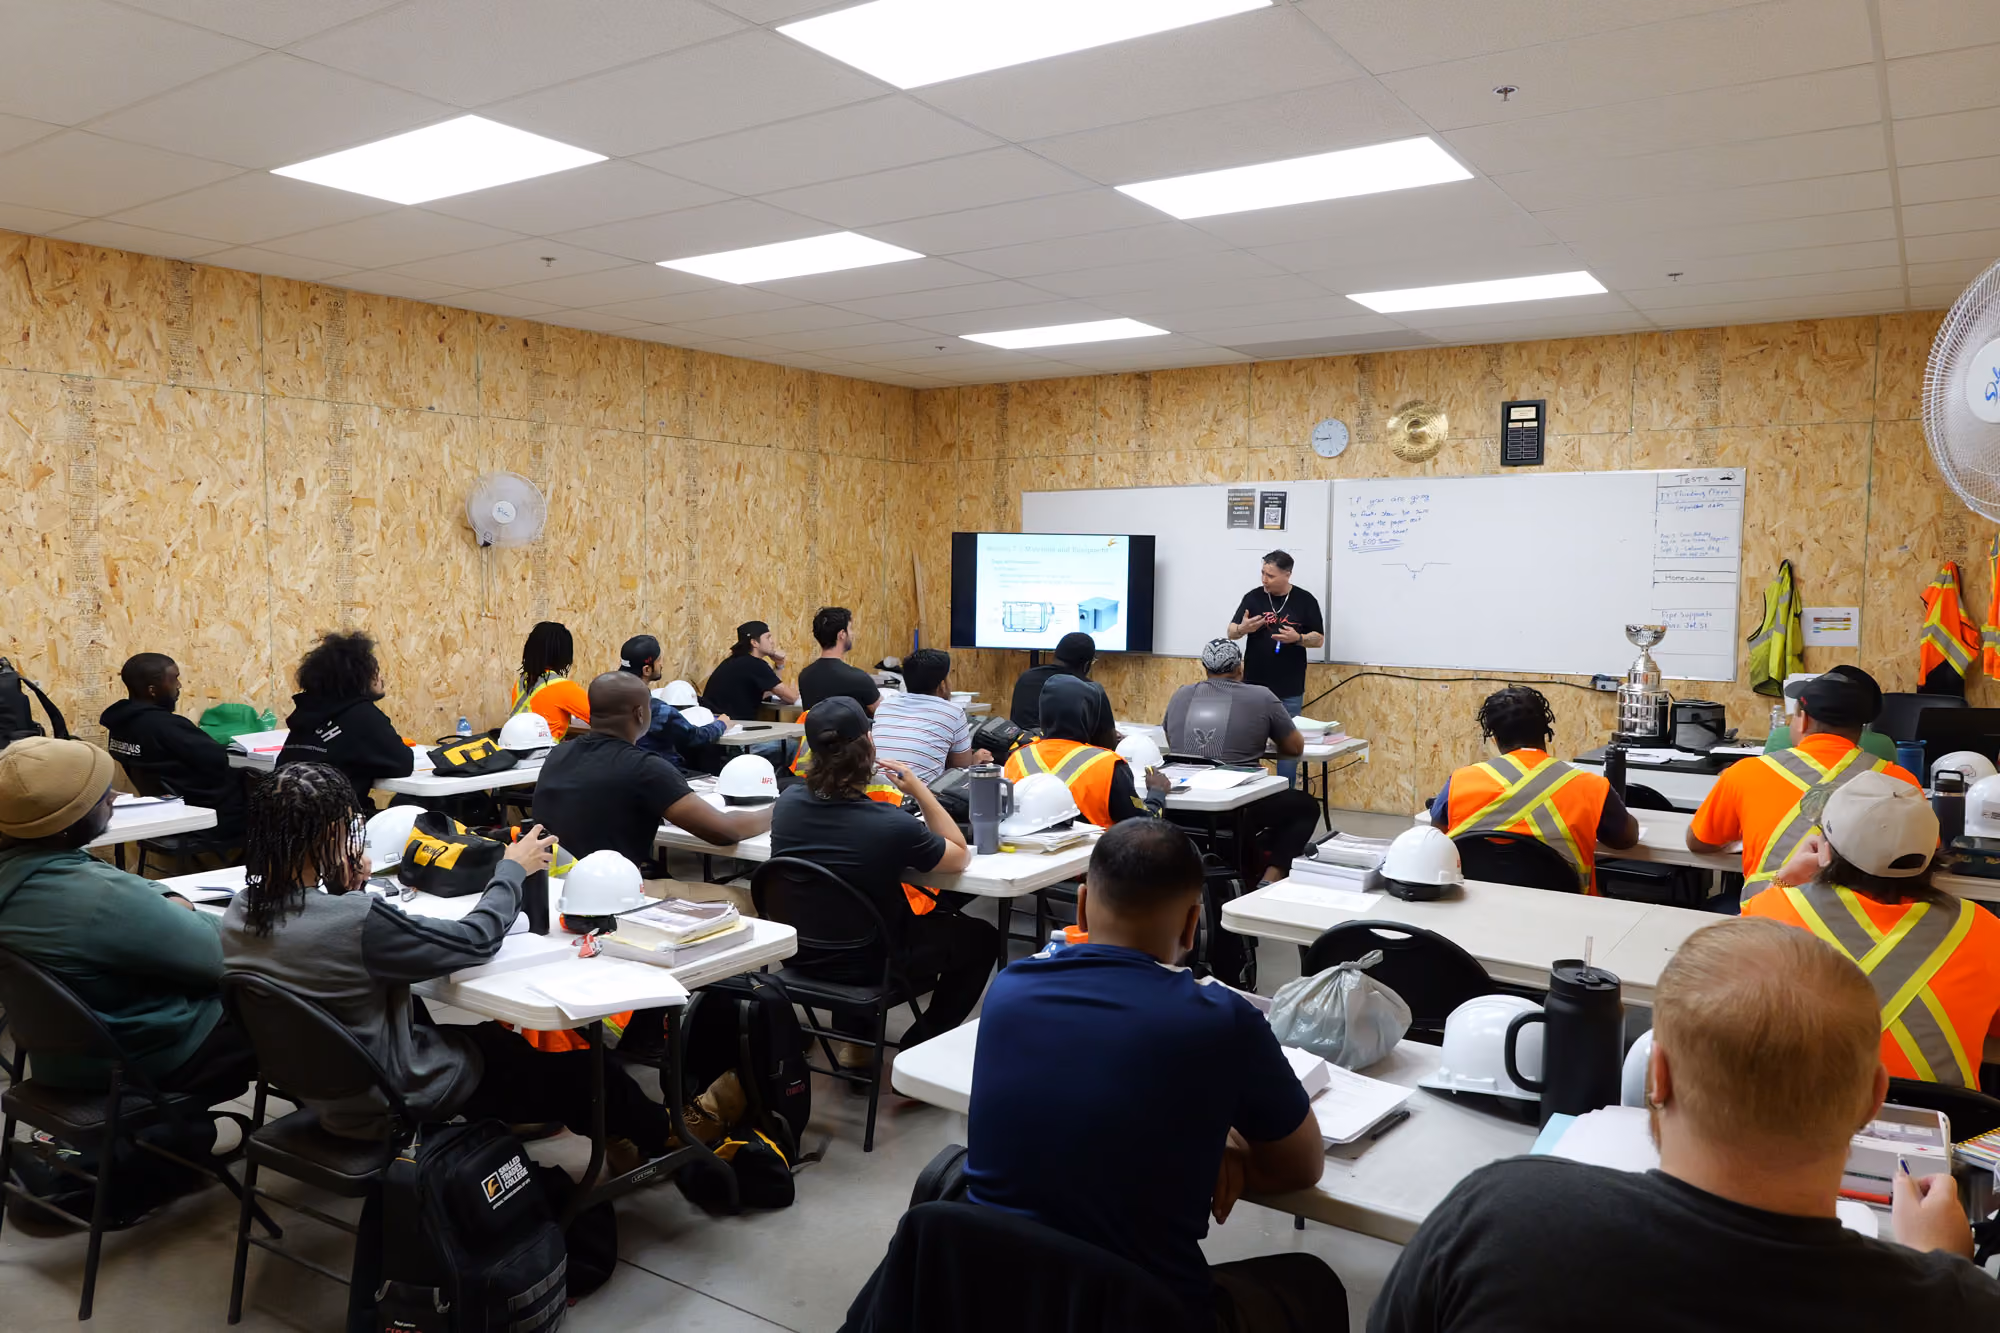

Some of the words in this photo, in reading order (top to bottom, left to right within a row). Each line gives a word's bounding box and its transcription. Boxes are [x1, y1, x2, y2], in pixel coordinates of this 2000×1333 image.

[498, 1155, 521, 1176] SKILLED
[501, 1162, 523, 1183] TRADES
[504, 1166, 529, 1190] COLLEGE
